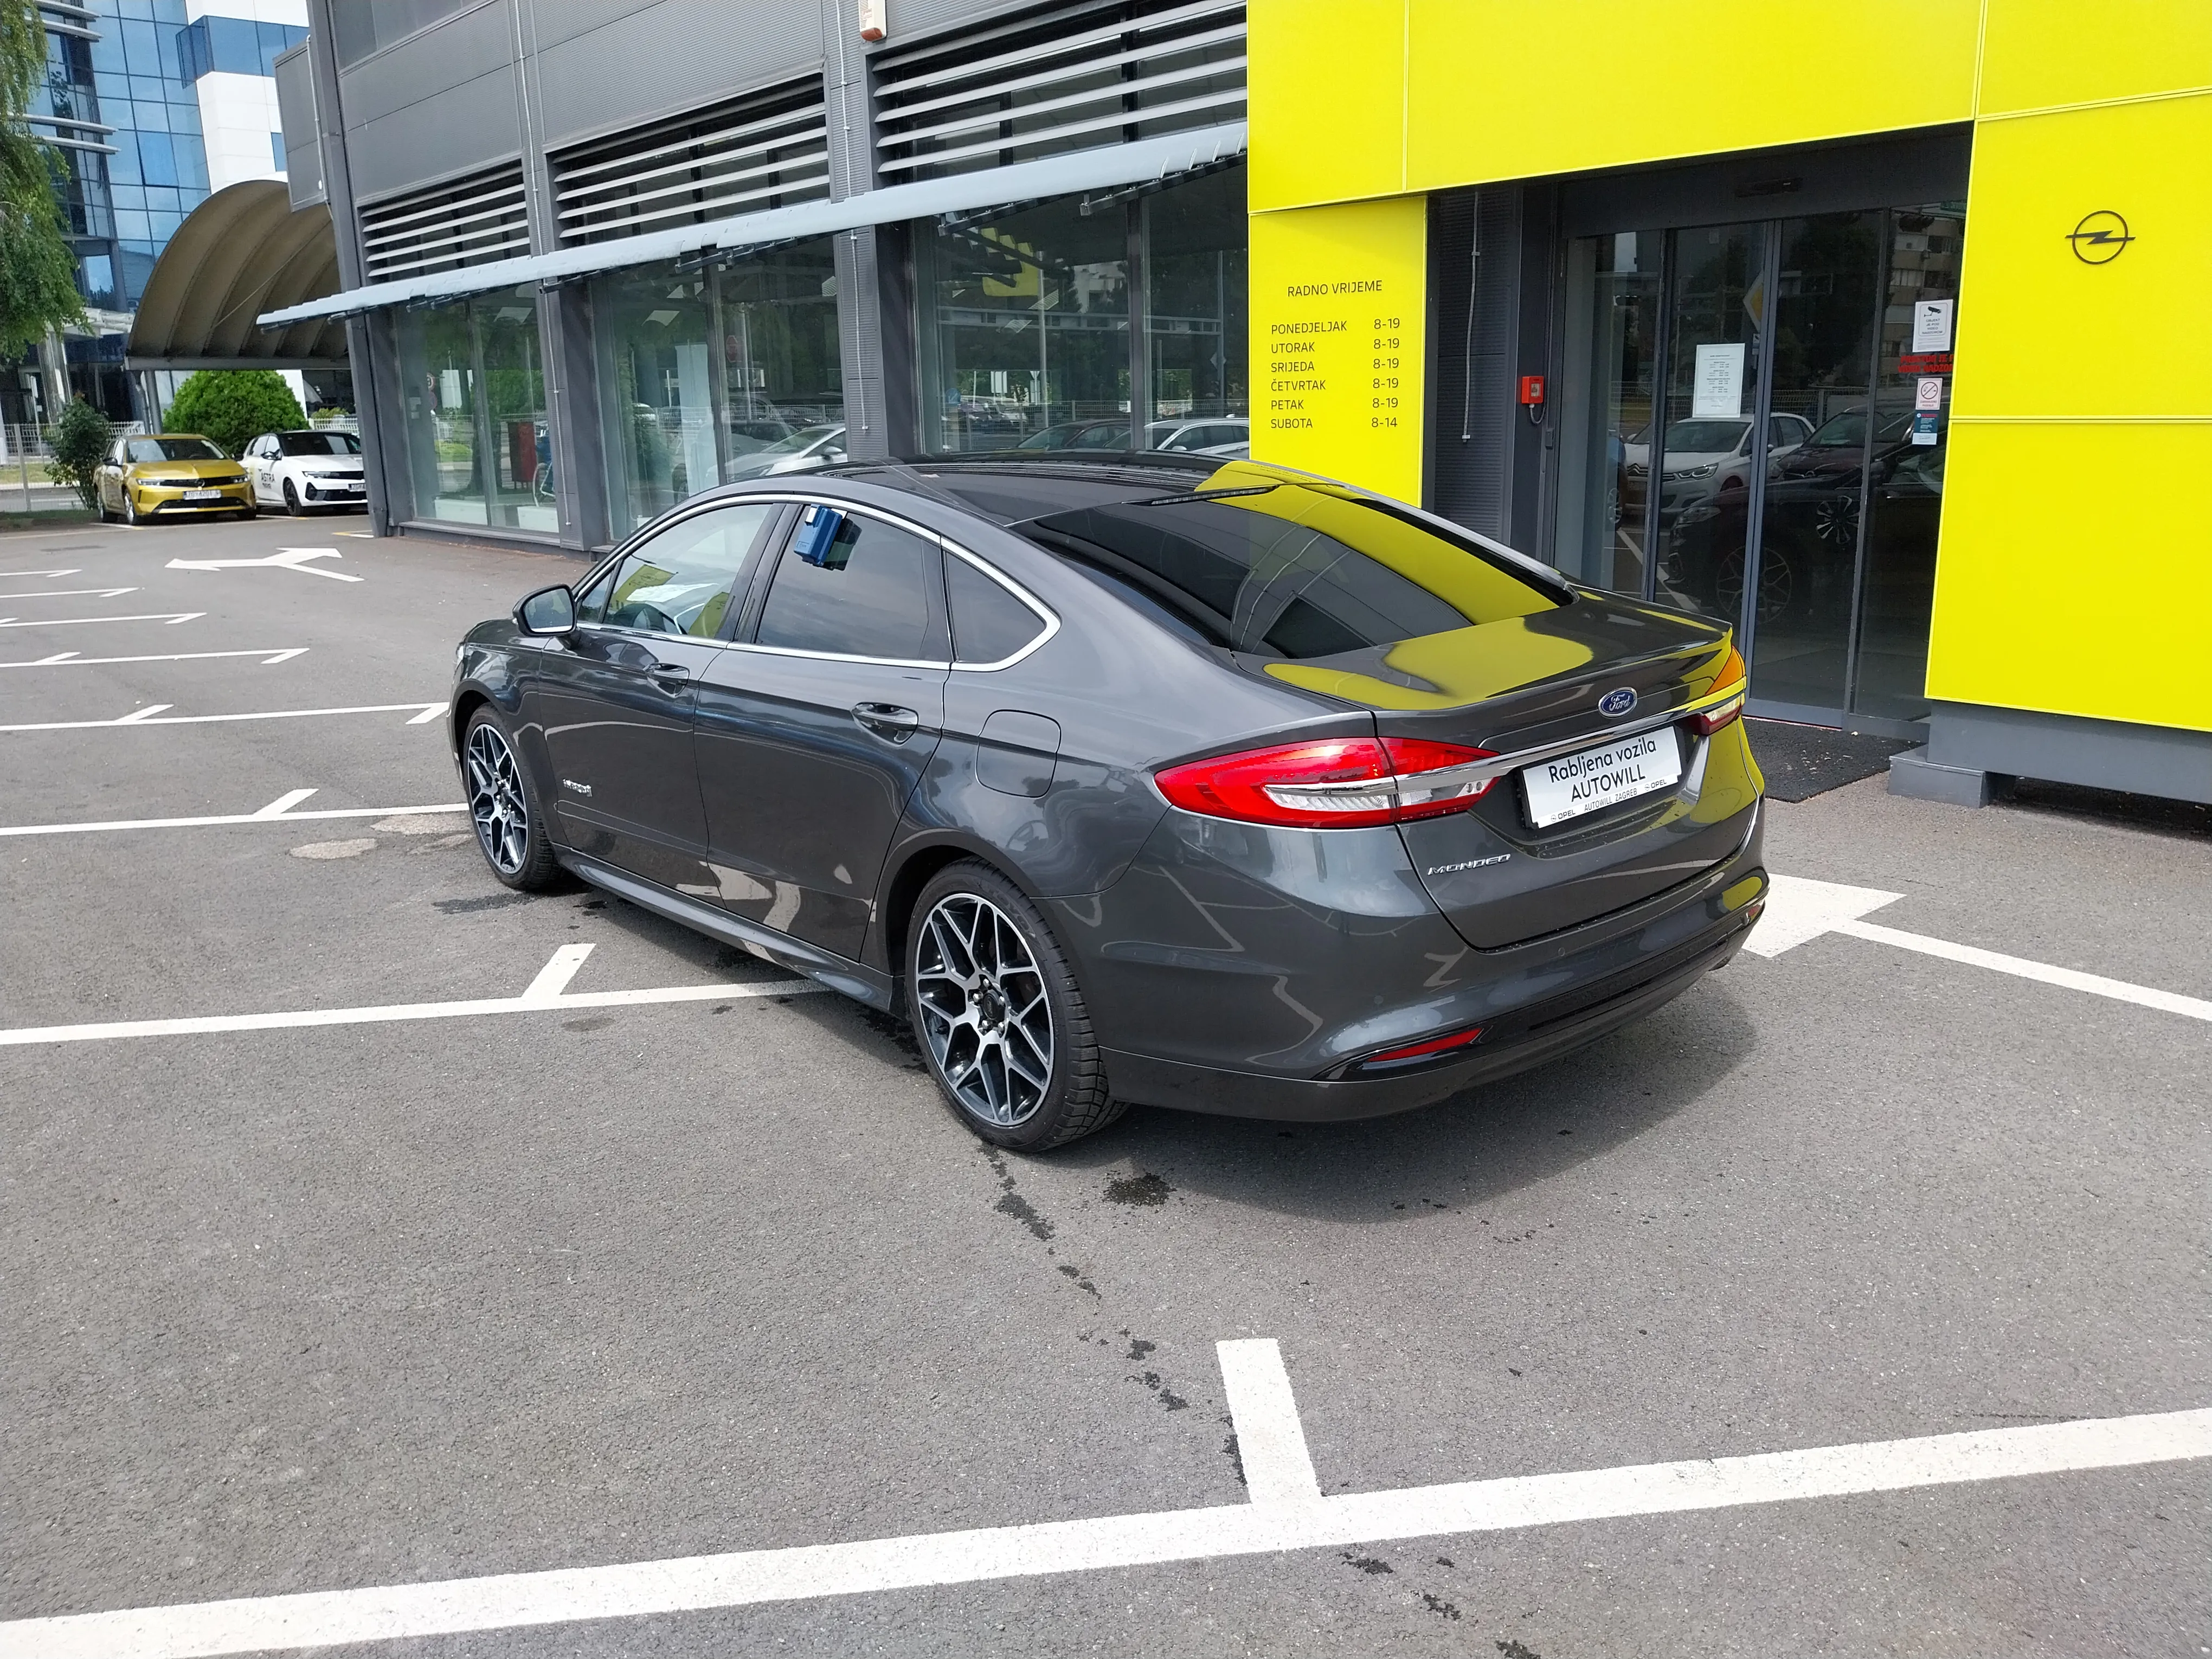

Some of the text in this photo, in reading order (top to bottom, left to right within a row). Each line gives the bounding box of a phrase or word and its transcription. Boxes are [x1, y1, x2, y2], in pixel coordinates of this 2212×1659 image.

[1288, 280, 1382, 297] RADNO VRIJEME
[1271, 318, 1400, 335] PONEDJELJAK 8-19
[1271, 338, 1399, 353] UTORAK 8-19
[1271, 358, 1399, 372] SRIJEDA 8-19
[1271, 378, 1399, 391] ČETVRTAK 8-19
[1271, 397, 1398, 410] PETAK 8-19
[1271, 417, 1398, 428] SUBOTA 8-14
[261, 472, 276, 483] ASTRA
[1609, 693, 1630, 711] Ford
[1548, 737, 1657, 783] Rabljena vozila
[1571, 764, 1646, 802] AUTOWILL
[1558, 779, 1667, 820] OPEL AUTOWILL ZAGREB OPEL
[1427, 853, 1511, 875] MONDEO
